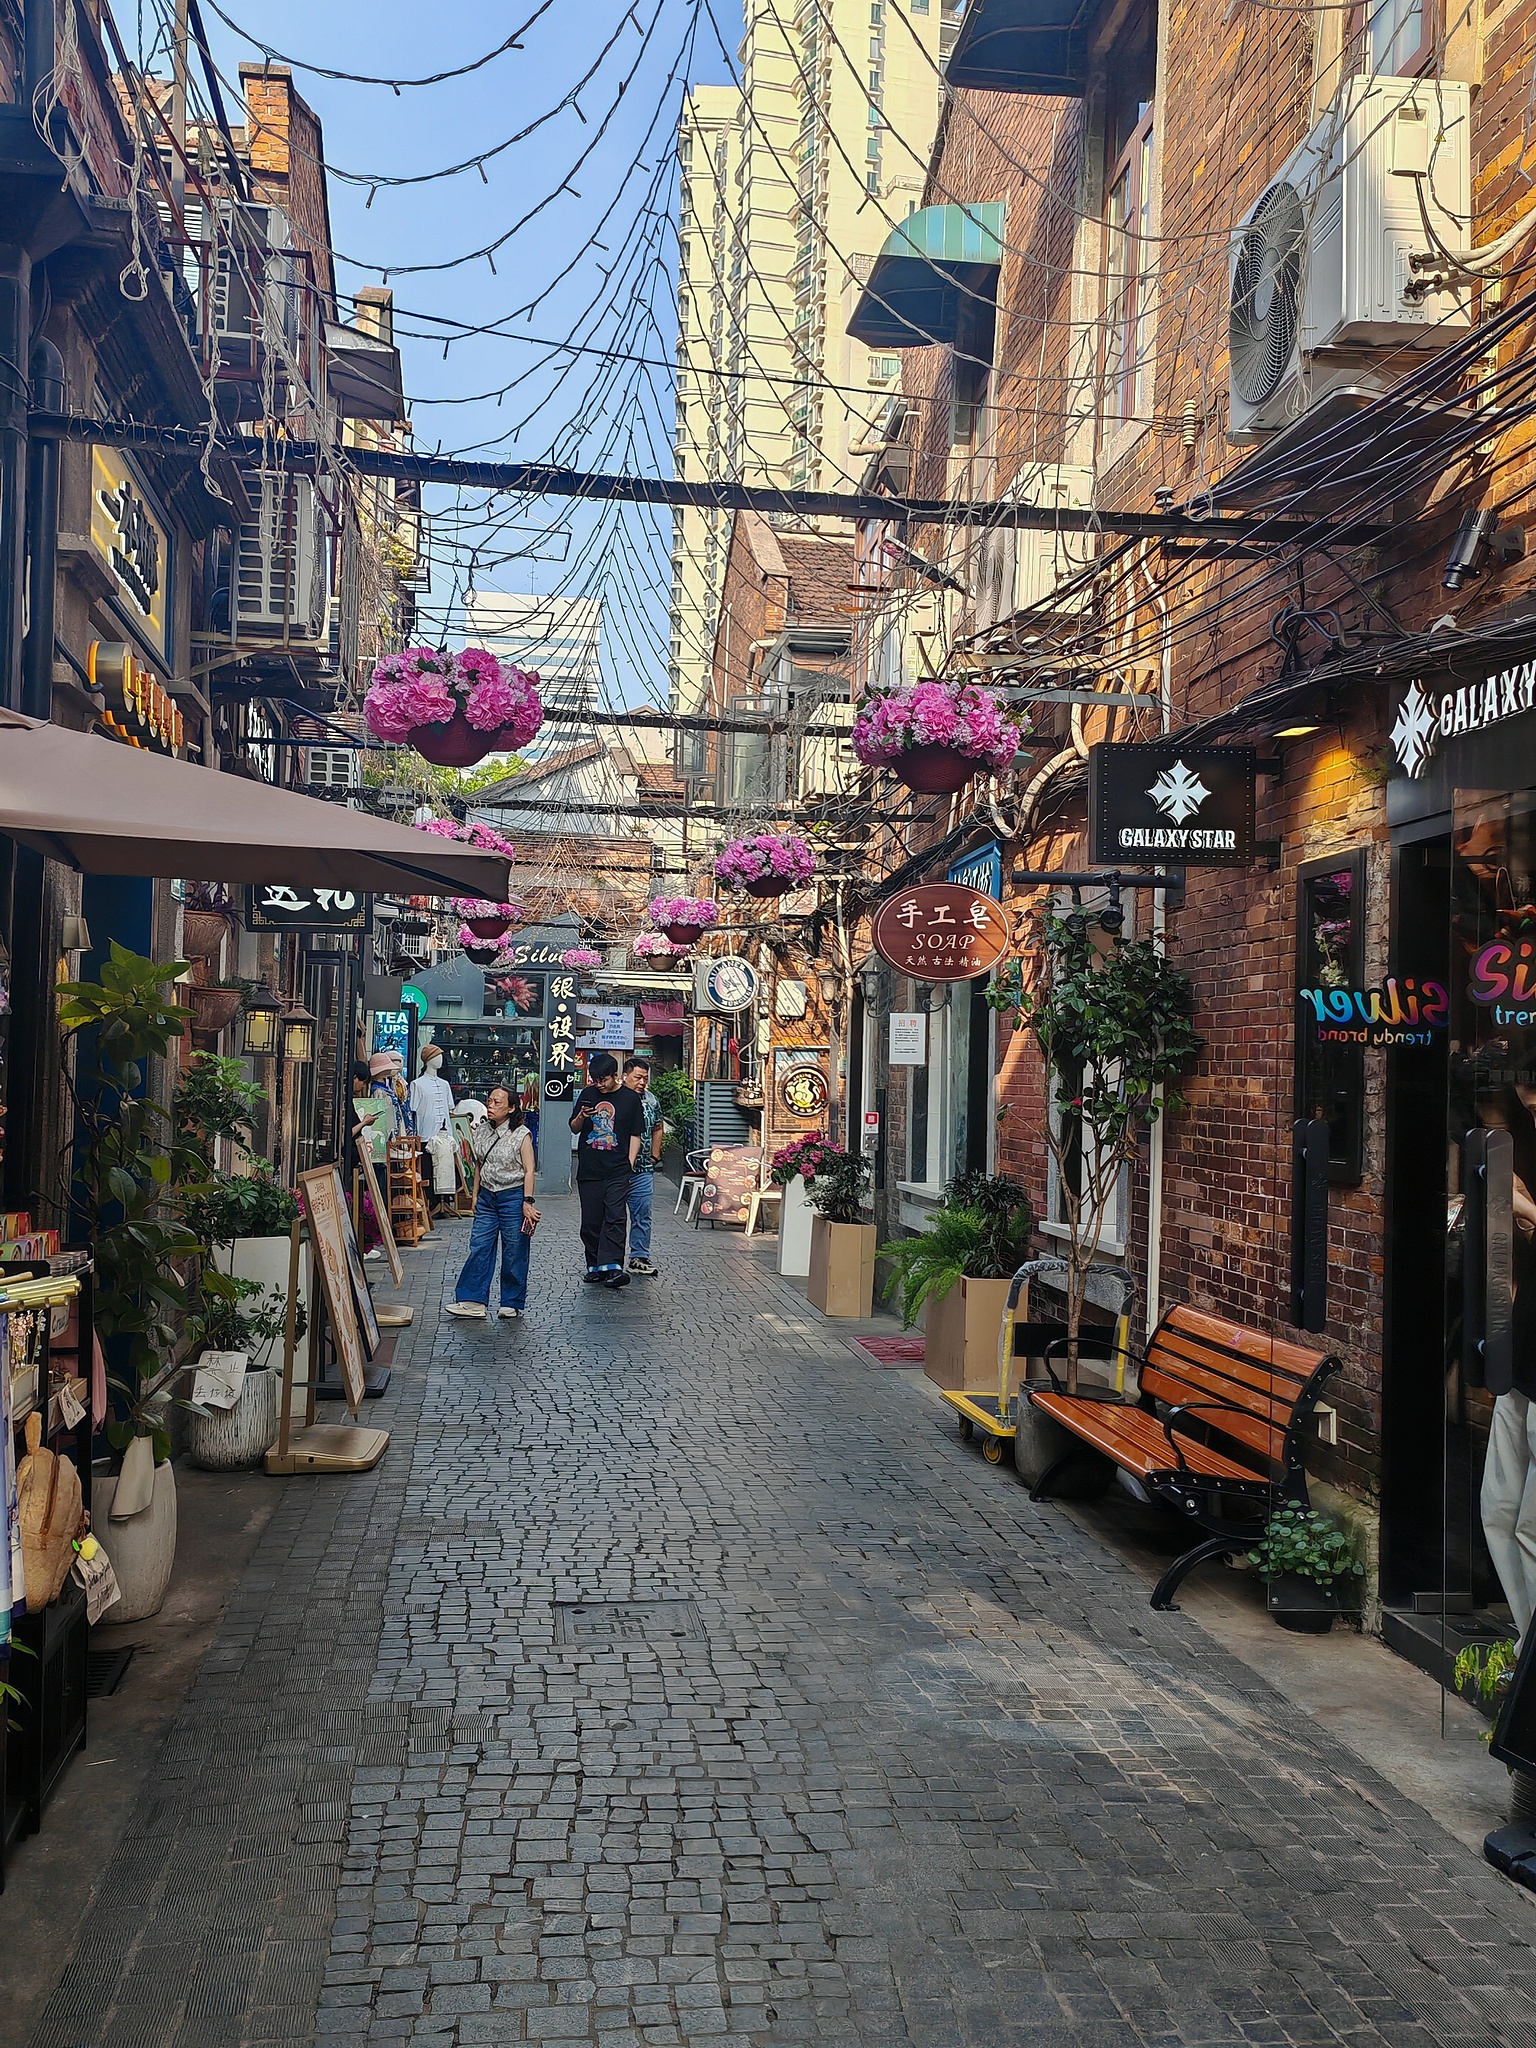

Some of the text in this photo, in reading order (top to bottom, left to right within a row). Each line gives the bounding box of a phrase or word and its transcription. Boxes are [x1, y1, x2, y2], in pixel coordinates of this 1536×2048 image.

[1438, 657, 1536, 738] GALAXY
[1118, 827, 1236, 849] GALAXY STAR
[896, 898, 991, 930] 手工皂
[910, 933, 976, 951] SOAP
[904, 955, 982, 968] 天然 古法 精油
[1471, 942, 1536, 1002] Si
[375, 1011, 409, 1024] TEA
[205, 1352, 242, 1376] 禁止
